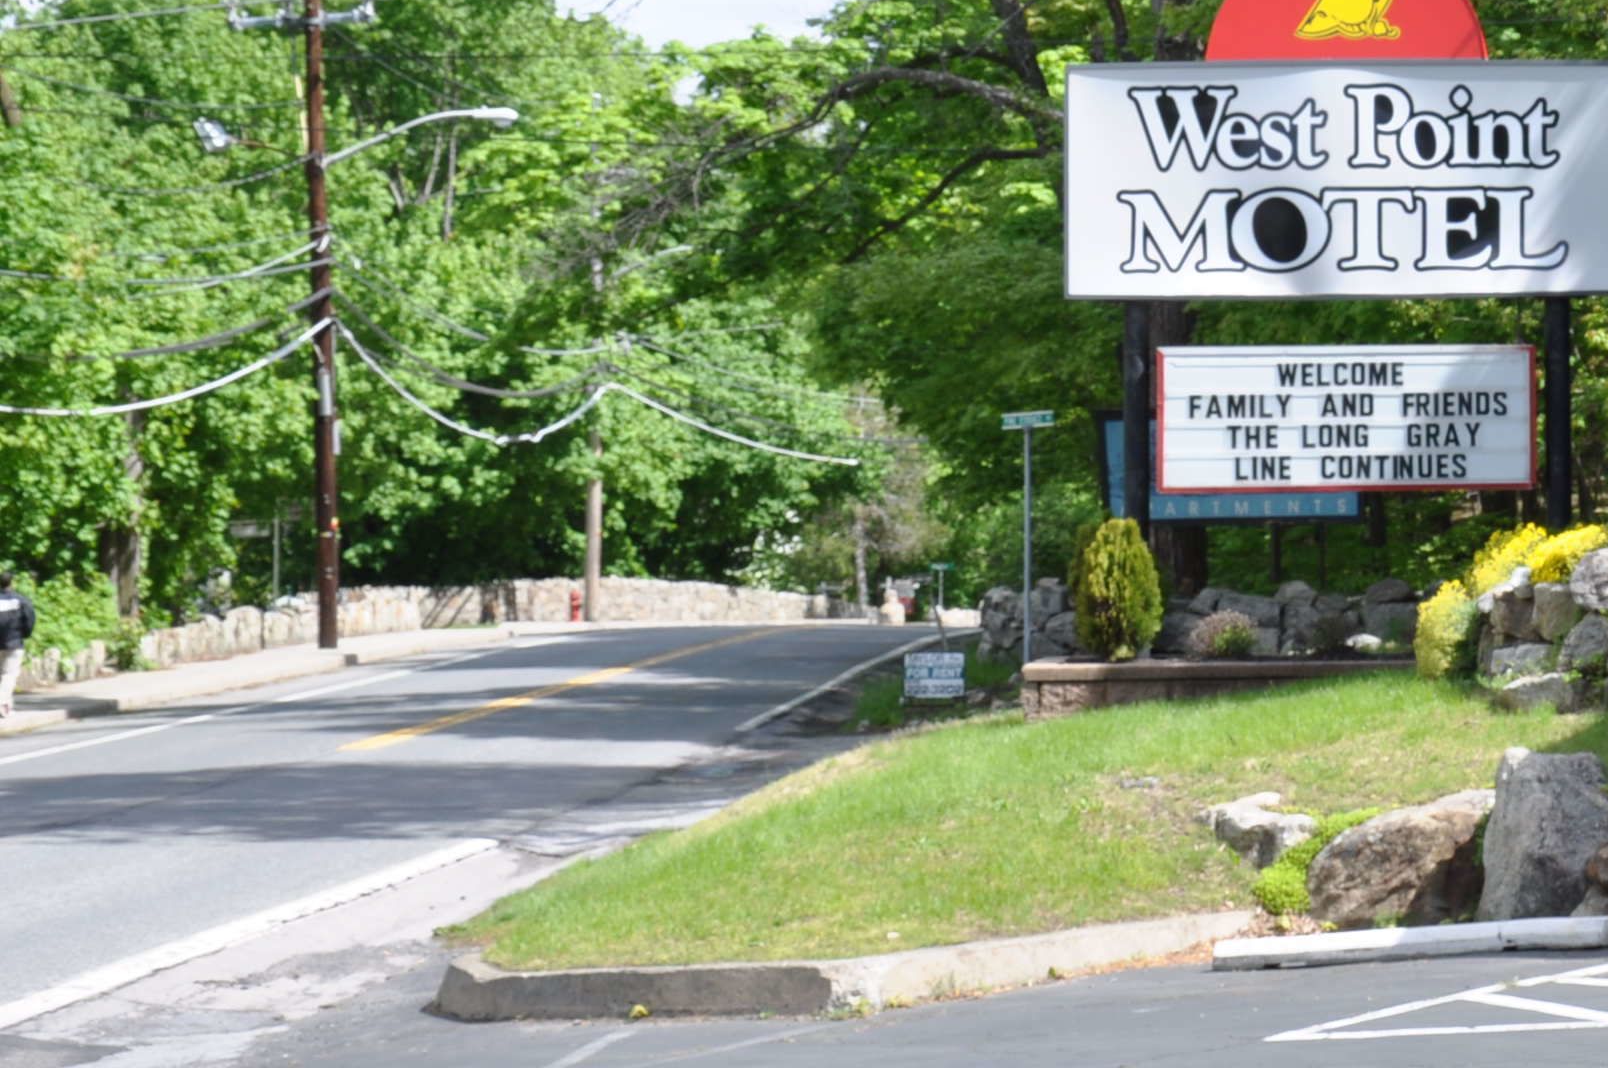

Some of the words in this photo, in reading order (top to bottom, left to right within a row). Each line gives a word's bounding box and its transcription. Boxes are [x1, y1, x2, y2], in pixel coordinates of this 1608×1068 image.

[1127, 84, 1329, 172] West
[1343, 83, 1560, 170] Point
[1116, 186, 1569, 273] MOTEL
[1277, 362, 1405, 387] WELCOME
[1188, 393, 1293, 420] FAMILY
[1320, 392, 1375, 418] AND
[1402, 391, 1509, 418] FRIENDS
[1226, 425, 1280, 450] THE
[1301, 424, 1370, 449] LONG
[1406, 422, 1482, 448] GRAY
[1234, 456, 1292, 481] LINE
[1320, 454, 1468, 480] CONTINUES
[1120, 498, 1349, 517] ARTMENTS
